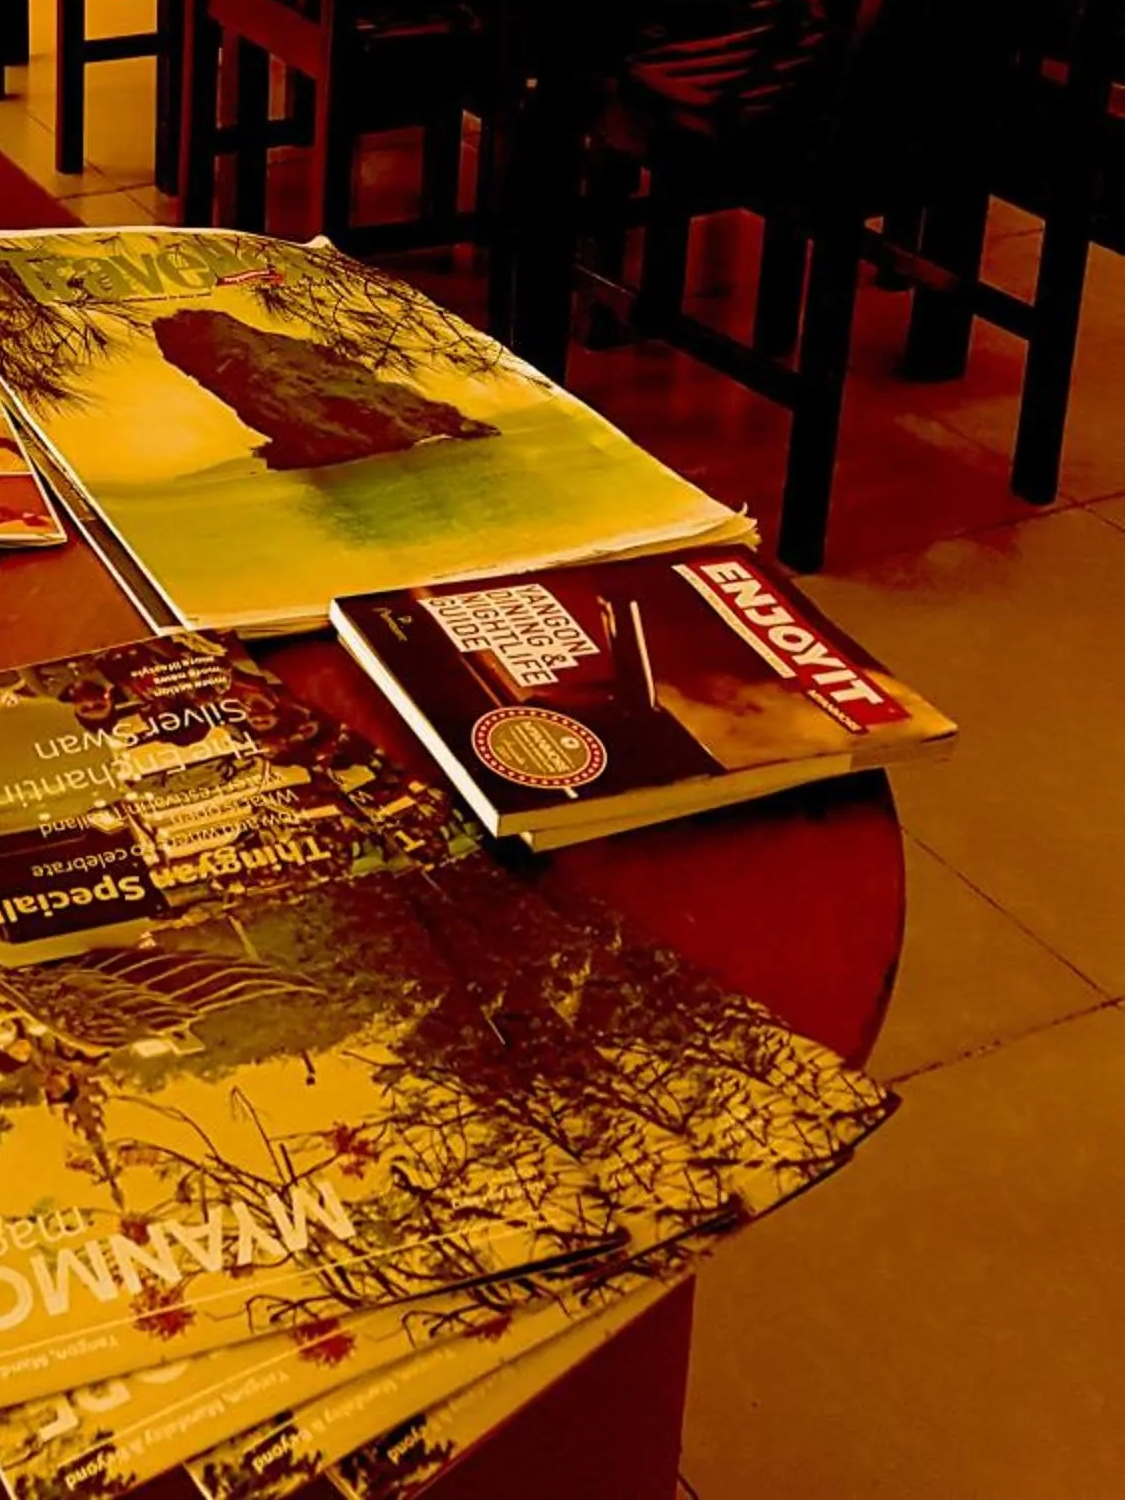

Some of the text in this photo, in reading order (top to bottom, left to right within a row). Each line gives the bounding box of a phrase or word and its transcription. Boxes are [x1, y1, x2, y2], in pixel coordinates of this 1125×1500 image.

[428, 599, 490, 650] GUIDE
[456, 594, 552, 684] NIGHTLIFE
[486, 590, 566, 667] DINING &
[515, 585, 593, 653] YANGON
[34, 696, 247, 759] Silver Swan
[188, 729, 262, 761] The
[31, 847, 129, 878] celebrate
[149, 834, 332, 890] Thingyan
